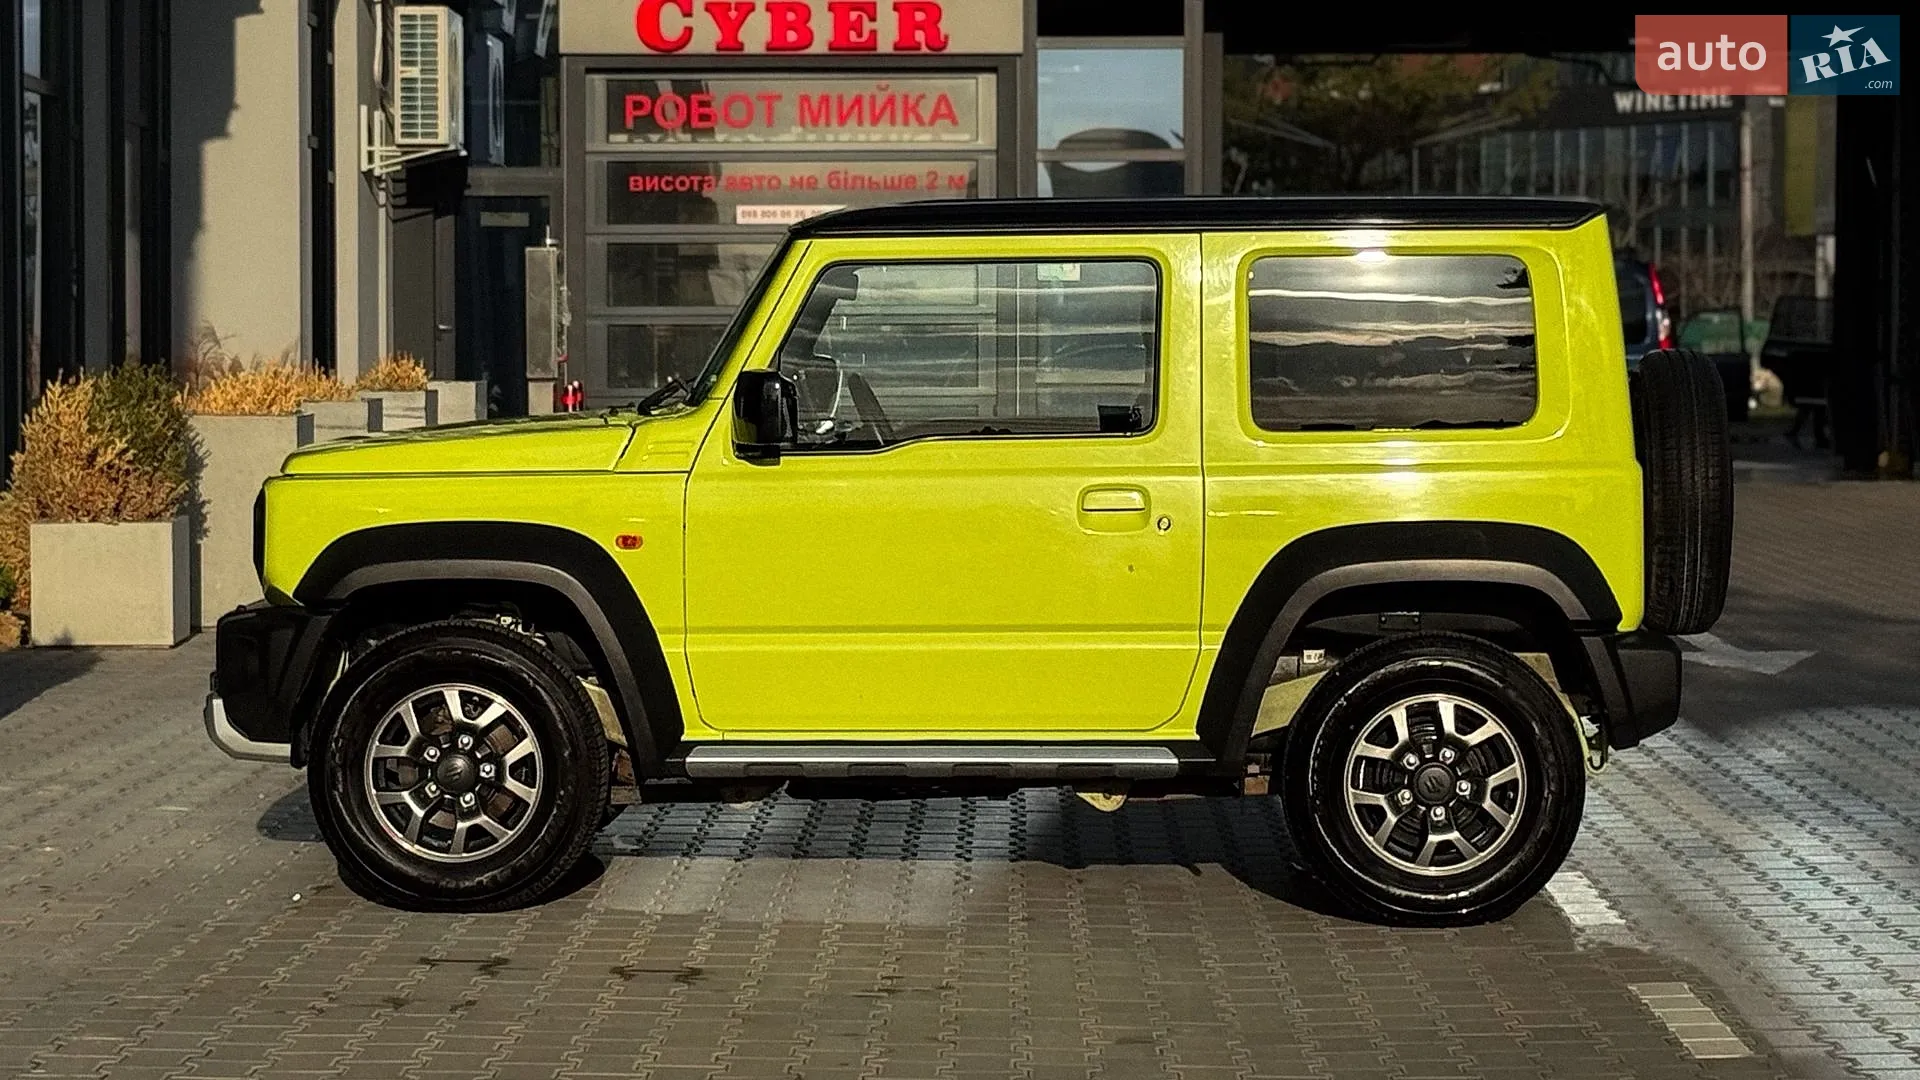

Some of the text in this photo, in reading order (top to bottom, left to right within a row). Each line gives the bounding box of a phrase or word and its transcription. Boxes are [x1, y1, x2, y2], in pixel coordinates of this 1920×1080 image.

[636, 0, 949, 52] CYBER
[624, 81, 959, 130] РОБОТ МИЙКА
[1613, 86, 1733, 113] WINETIME
[628, 170, 966, 193] висота авто не більше 2 м
